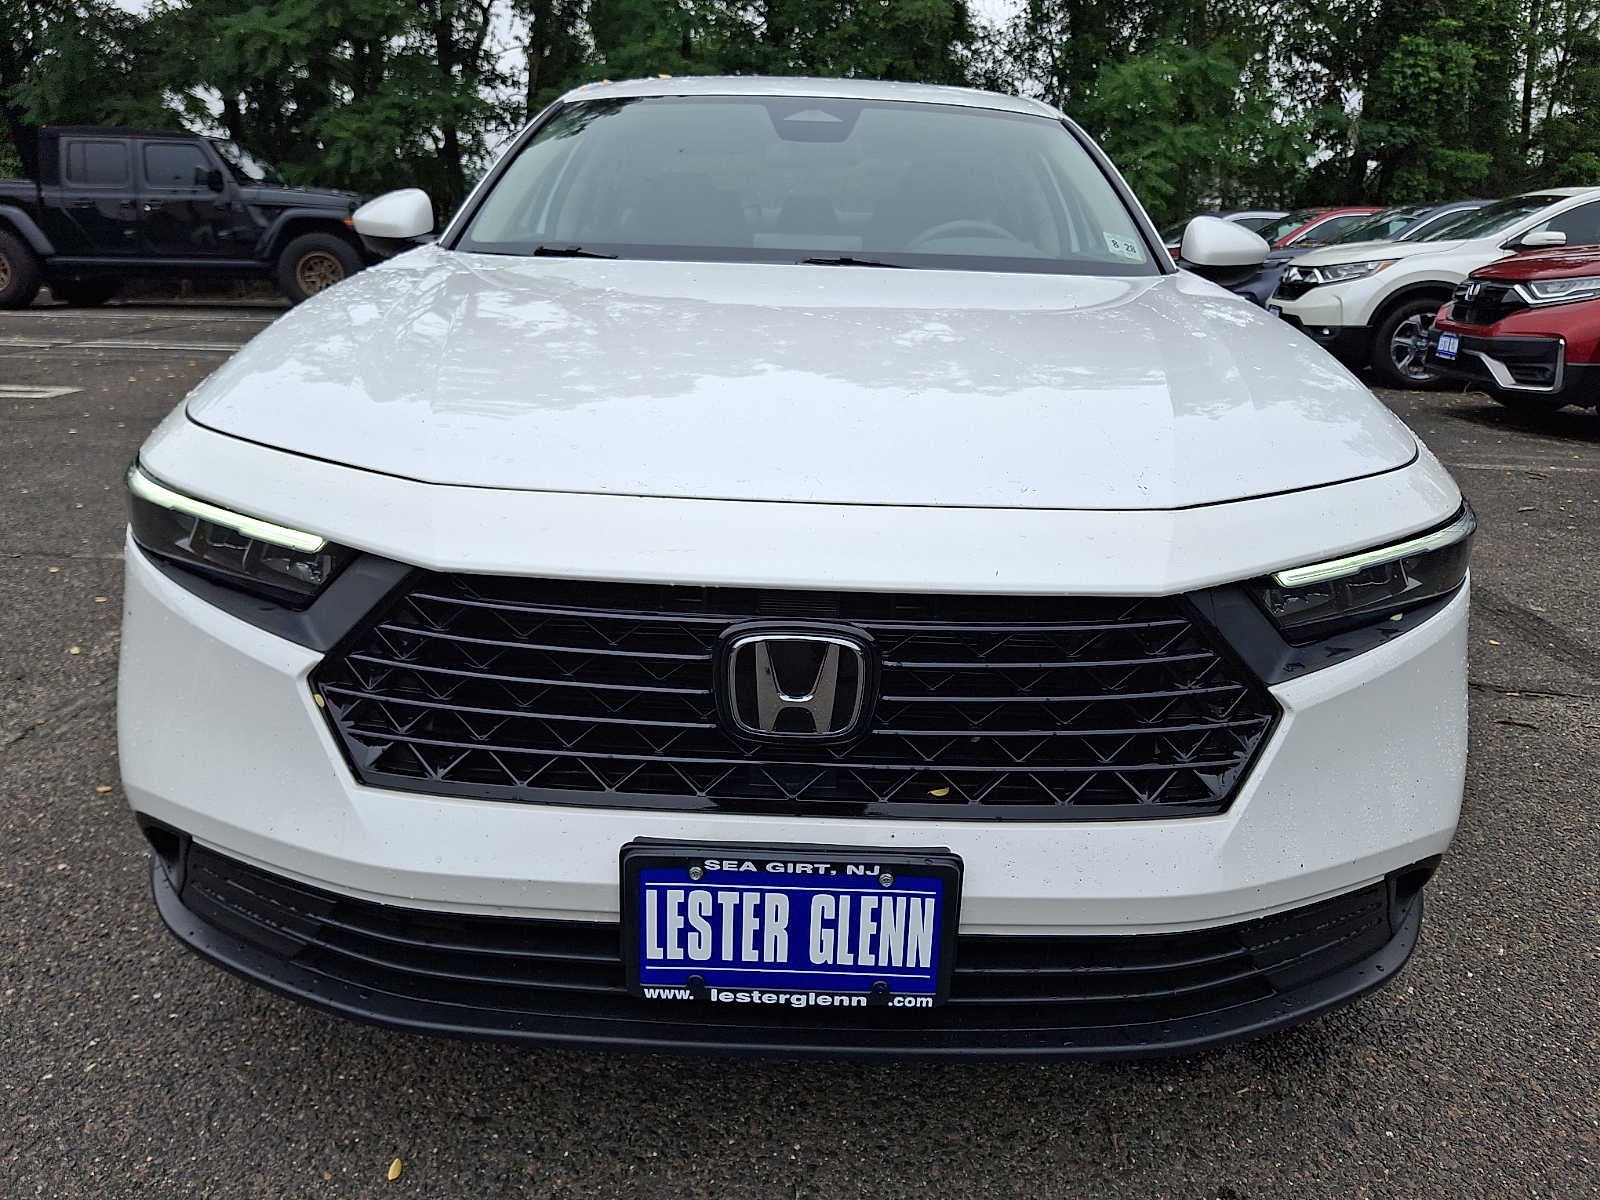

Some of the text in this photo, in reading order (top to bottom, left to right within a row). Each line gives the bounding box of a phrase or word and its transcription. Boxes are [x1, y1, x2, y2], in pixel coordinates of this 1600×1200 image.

[755, 641, 840, 733] H
[704, 860, 881, 876] SEA GIRT, NJ
[645, 889, 936, 968] LESTER GLENN
[643, 988, 933, 1008] www. lesterglenn .com
